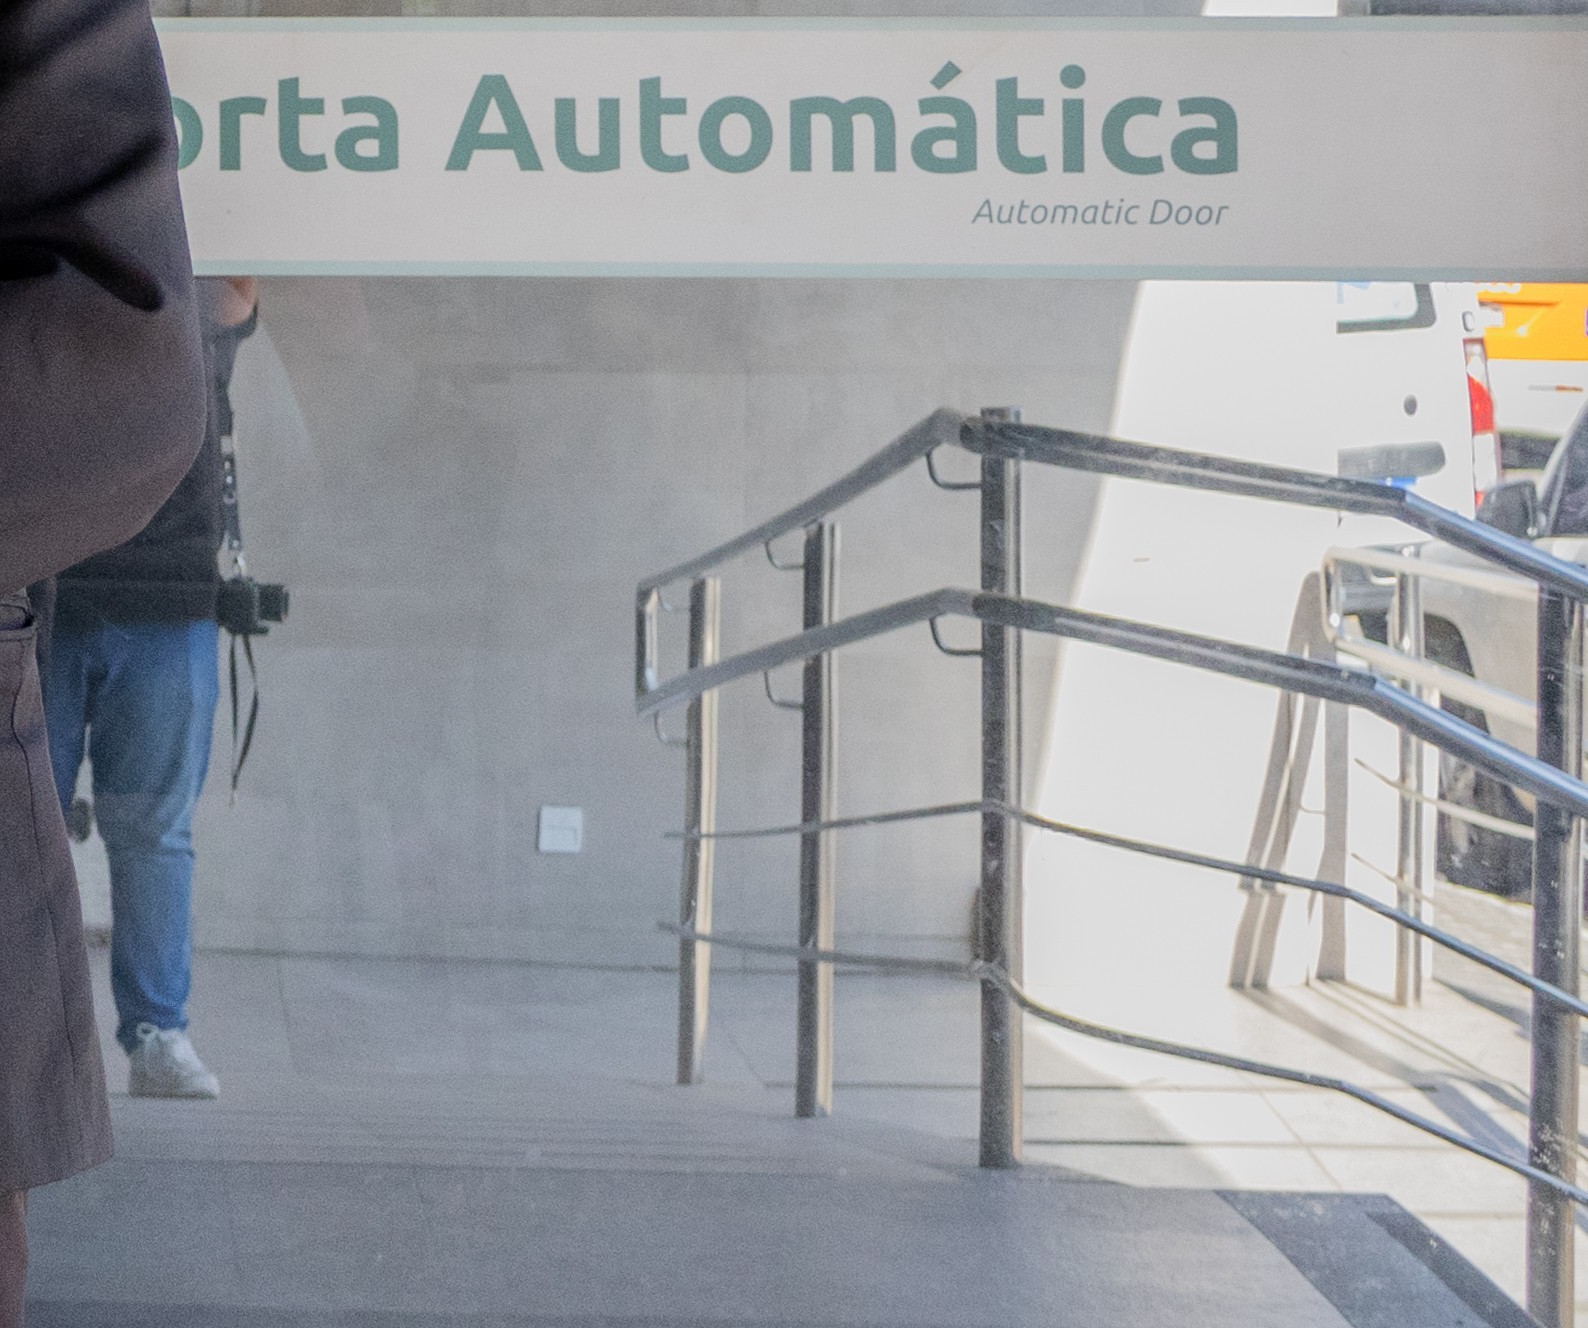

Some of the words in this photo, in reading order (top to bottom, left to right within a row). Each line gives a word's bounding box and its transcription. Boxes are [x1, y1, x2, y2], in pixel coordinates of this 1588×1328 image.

[444, 60, 1239, 175] Automática
[971, 198, 1140, 225] Automatic
[1148, 199, 1229, 225] Door
